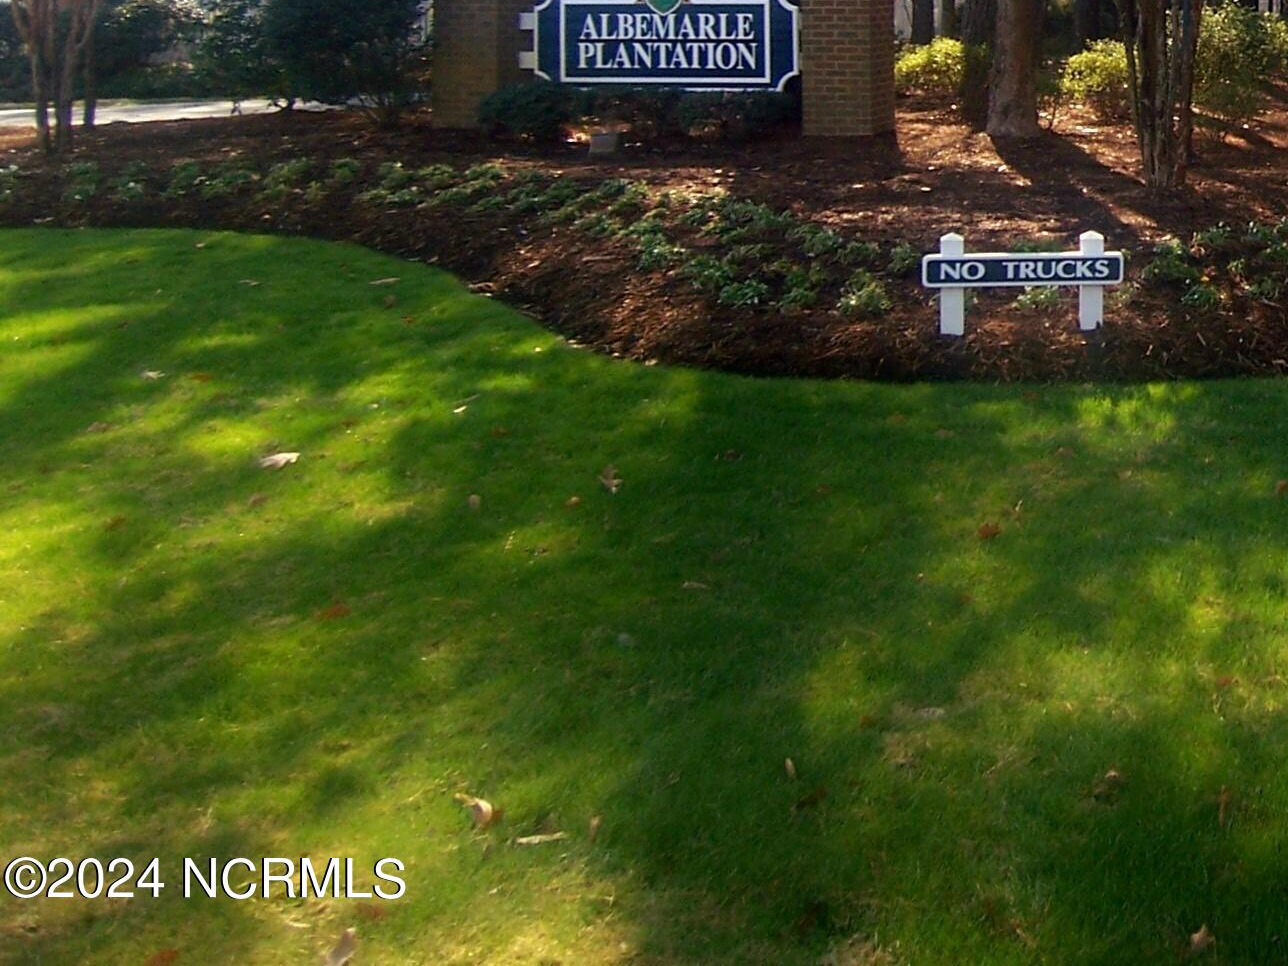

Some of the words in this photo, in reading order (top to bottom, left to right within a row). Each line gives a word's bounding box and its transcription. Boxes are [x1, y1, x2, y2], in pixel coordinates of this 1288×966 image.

[579, 14, 755, 39] ALBEMARLE
[578, 42, 757, 69] PLANTATION
[940, 262, 985, 280] NO
[1002, 260, 1109, 279] TRUCKS
